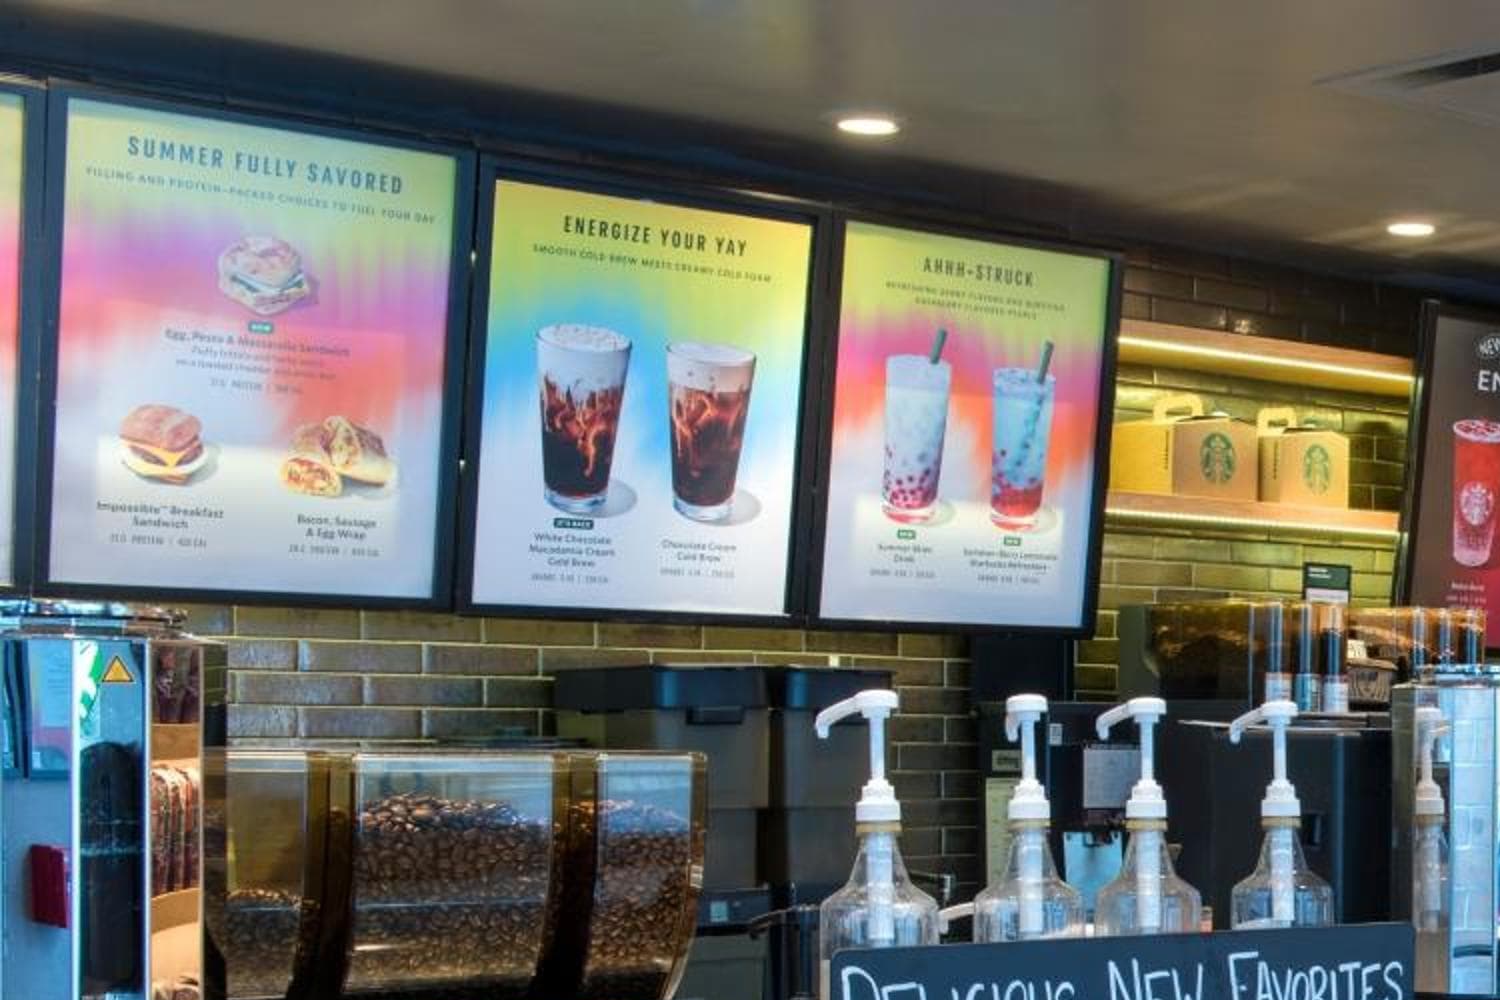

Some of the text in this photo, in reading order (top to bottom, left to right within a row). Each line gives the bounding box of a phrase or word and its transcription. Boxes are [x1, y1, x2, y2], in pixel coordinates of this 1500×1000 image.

[127, 135, 403, 195] SUMMER FULLY SAVORED
[85, 166, 135, 182] FILLING
[138, 174, 165, 186] AND
[381, 207, 411, 222] YOUR
[414, 213, 436, 225] DAY
[563, 214, 748, 257] ENERGIZE YOUR YAY
[532, 243, 772, 283] SMOOTH COLD BREW MEETS CREAMY COLD FOAM
[923, 256, 1034, 288] AHHH-STRUCK
[132, 515, 189, 529] Sandwich
[169, 505, 224, 519] Breakfast
[534, 532, 612, 545] White Chocolate
[547, 556, 596, 567] Cold Brew
